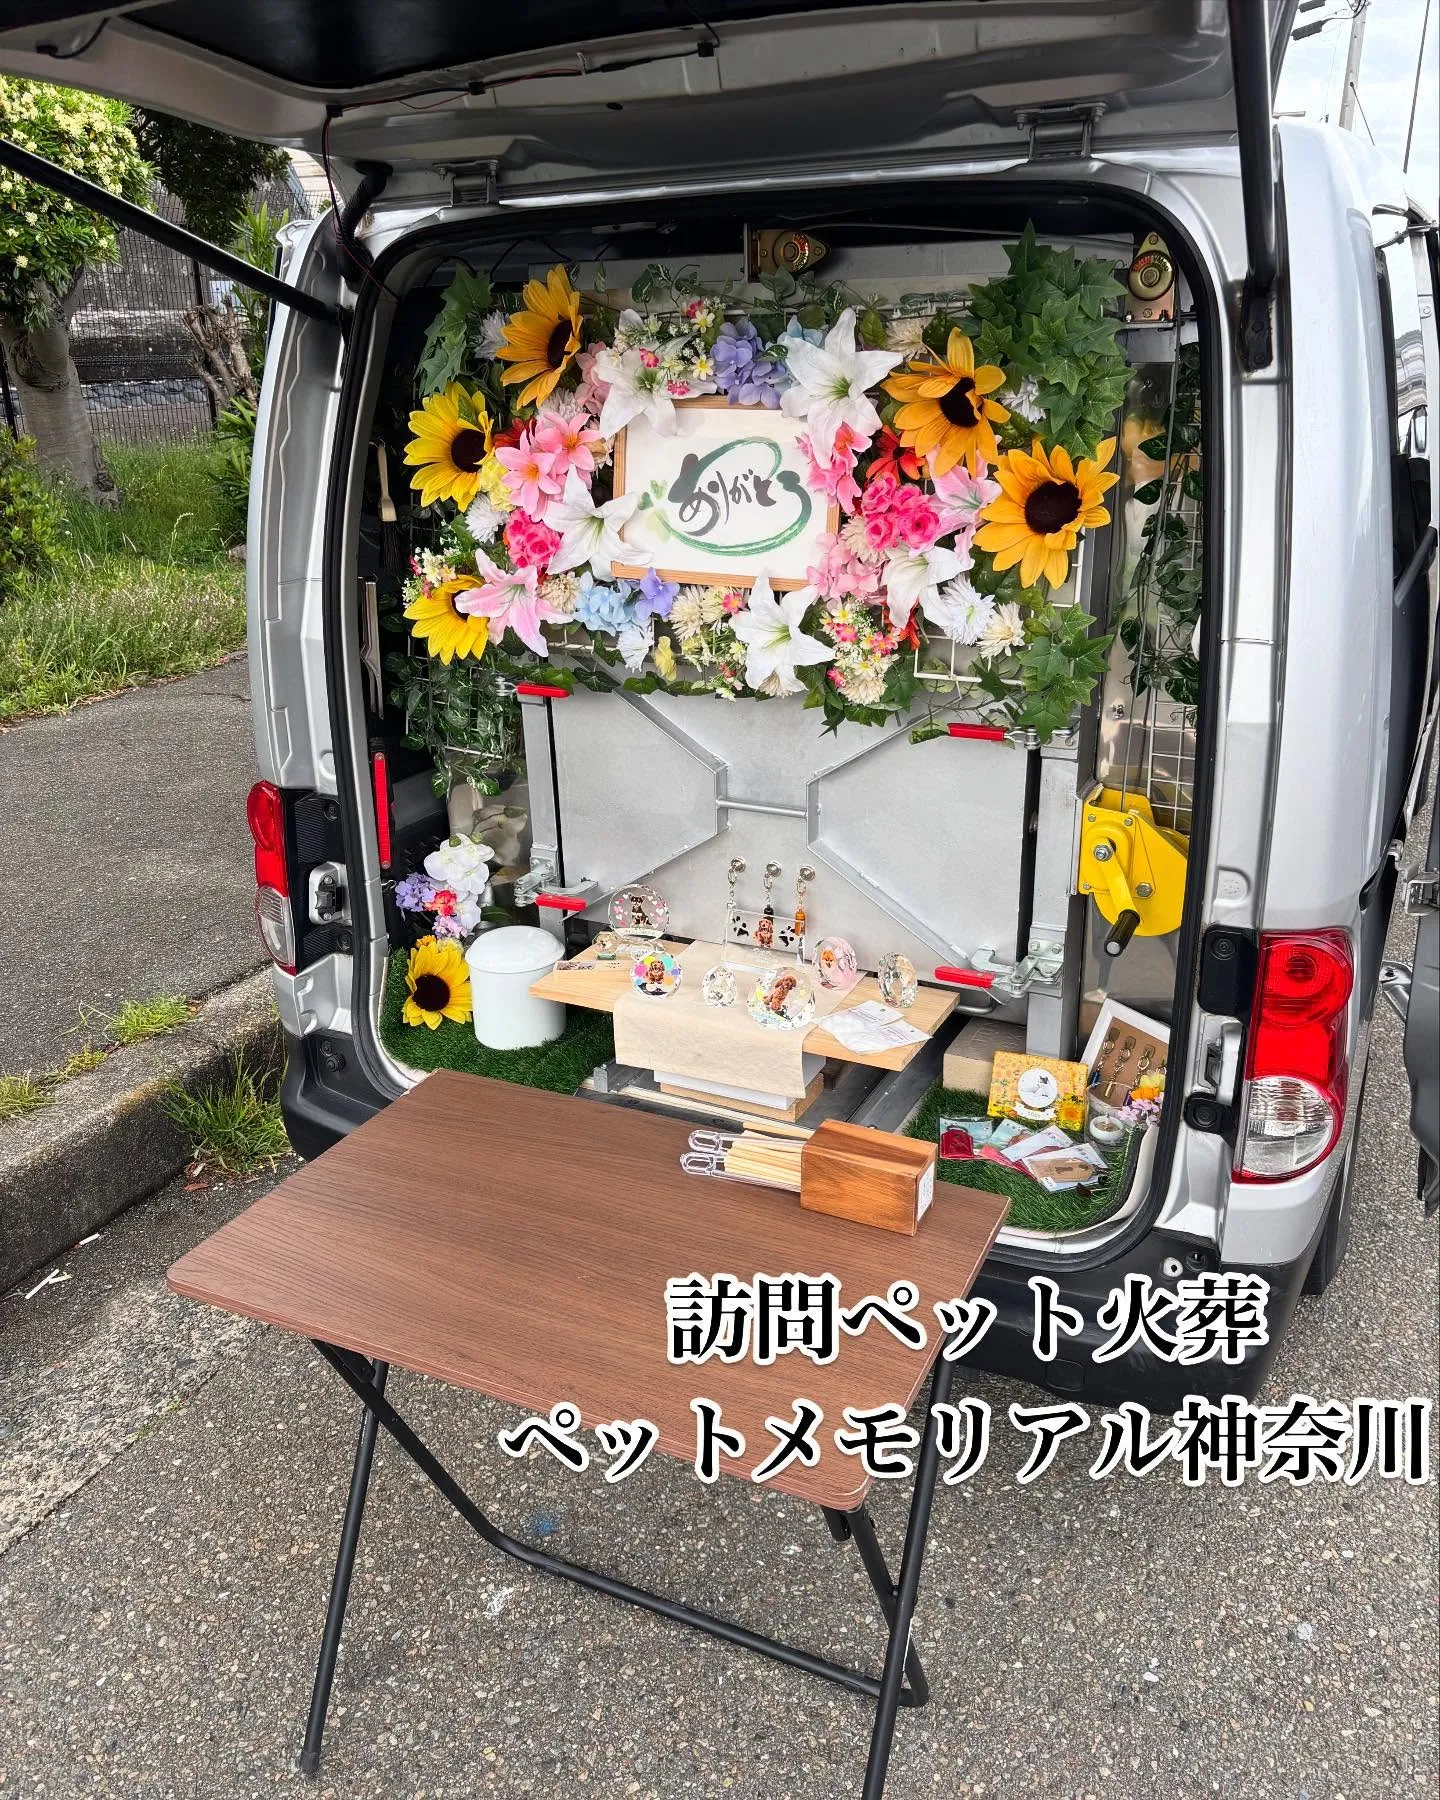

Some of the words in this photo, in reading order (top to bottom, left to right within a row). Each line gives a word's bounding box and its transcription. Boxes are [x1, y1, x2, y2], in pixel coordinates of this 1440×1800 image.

[662, 440, 812, 556] ありがとう
